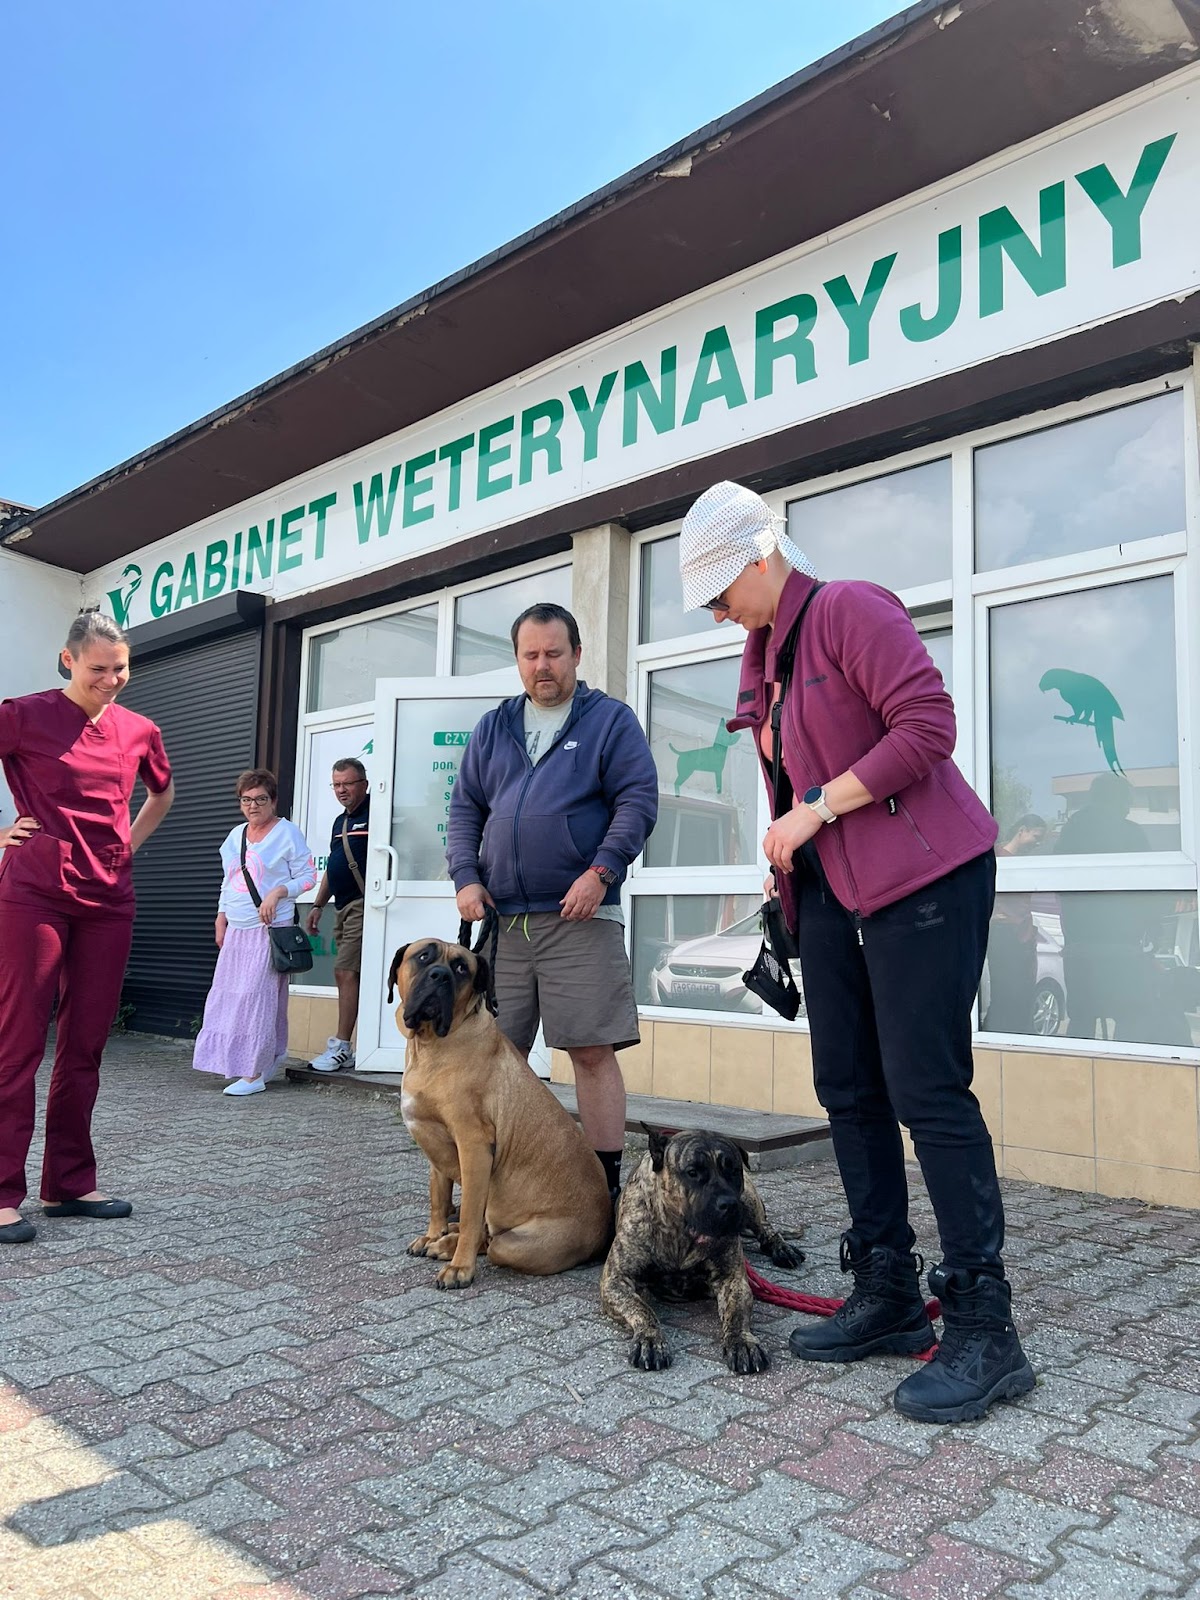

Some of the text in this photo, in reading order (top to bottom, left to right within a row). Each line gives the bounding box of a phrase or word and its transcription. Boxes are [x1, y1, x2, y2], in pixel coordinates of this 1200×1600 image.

[150, 132, 1178, 619] GABINET WETERYNARYJNY
[444, 732, 473, 745] CZY
[432, 761, 458, 772] pon.
[313, 856, 330, 871] LEK
